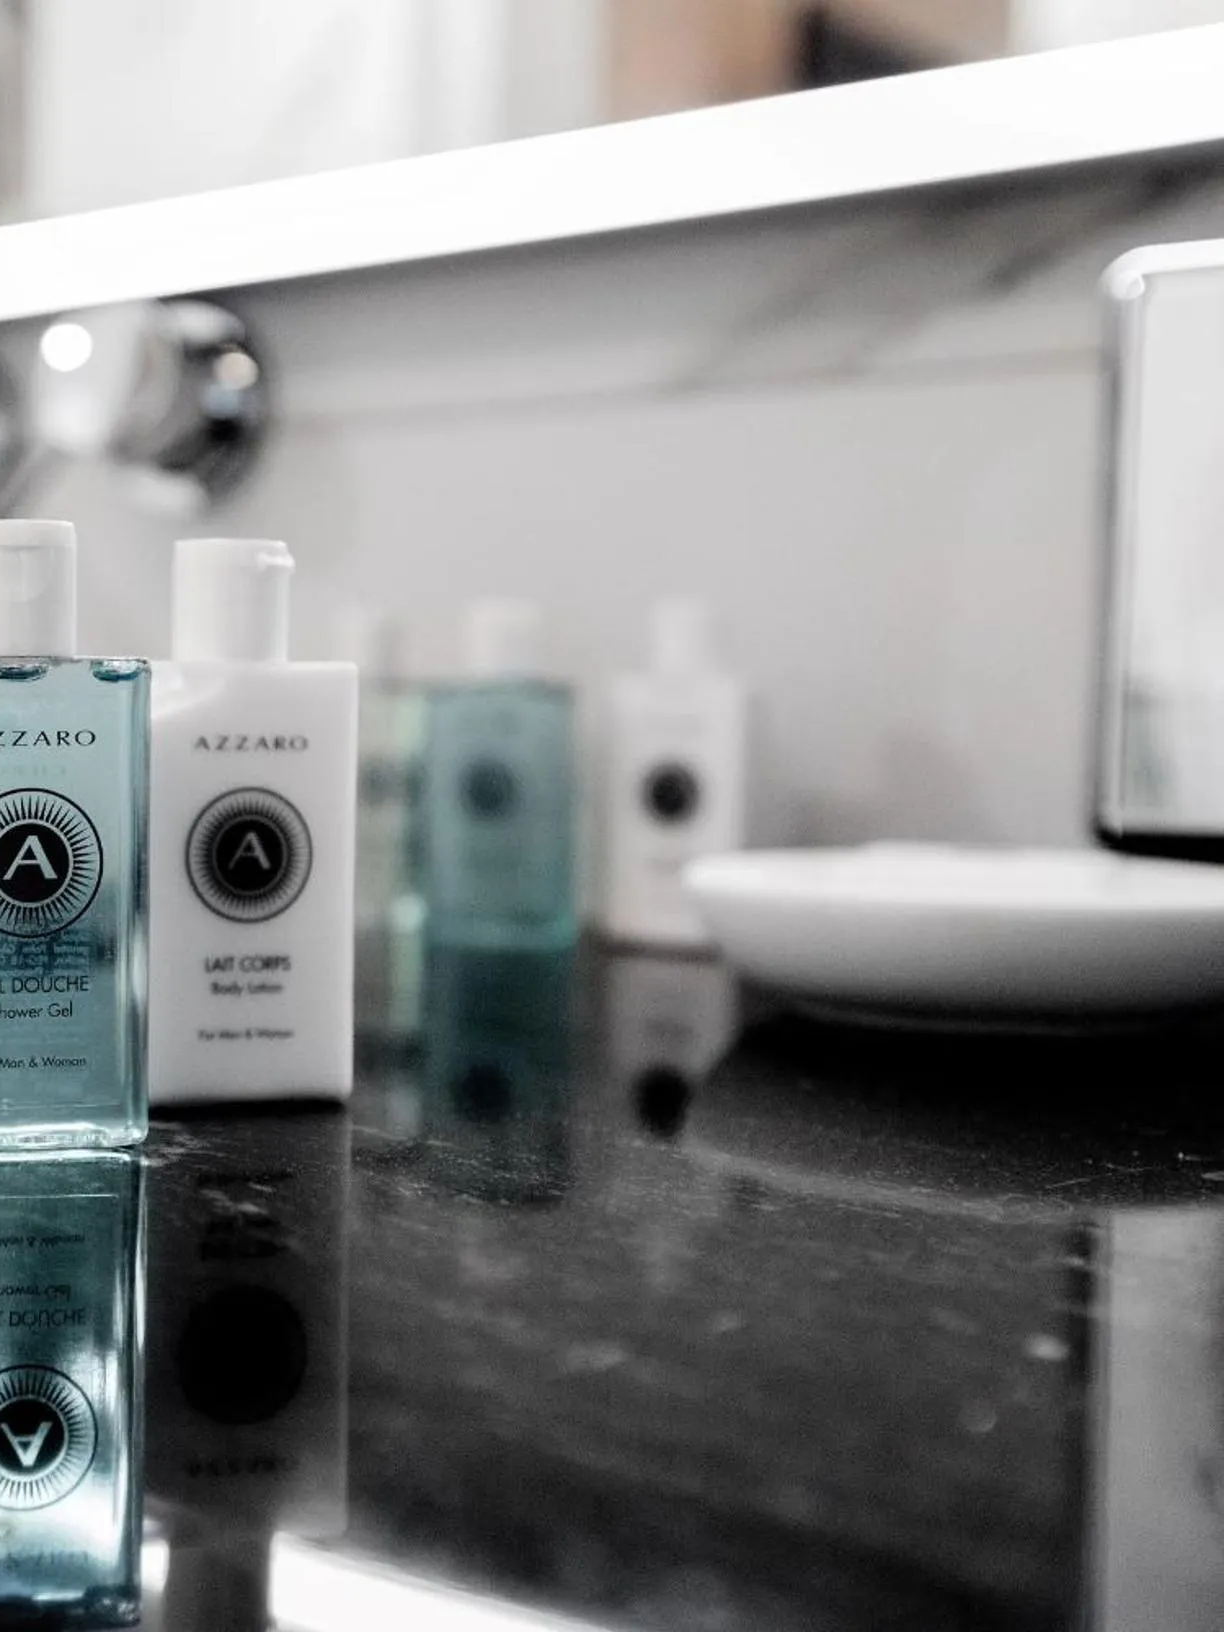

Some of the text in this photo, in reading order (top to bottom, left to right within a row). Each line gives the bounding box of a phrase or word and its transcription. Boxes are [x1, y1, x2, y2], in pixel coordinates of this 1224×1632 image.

[194, 735, 309, 752] AZZARO
[3, 835, 57, 880] A
[227, 831, 271, 870] A
[204, 955, 235, 974] LAIT
[11, 975, 90, 994] DOUCHE
[48, 1000, 73, 1018] Gel
[28, 1056, 39, 1068] &
